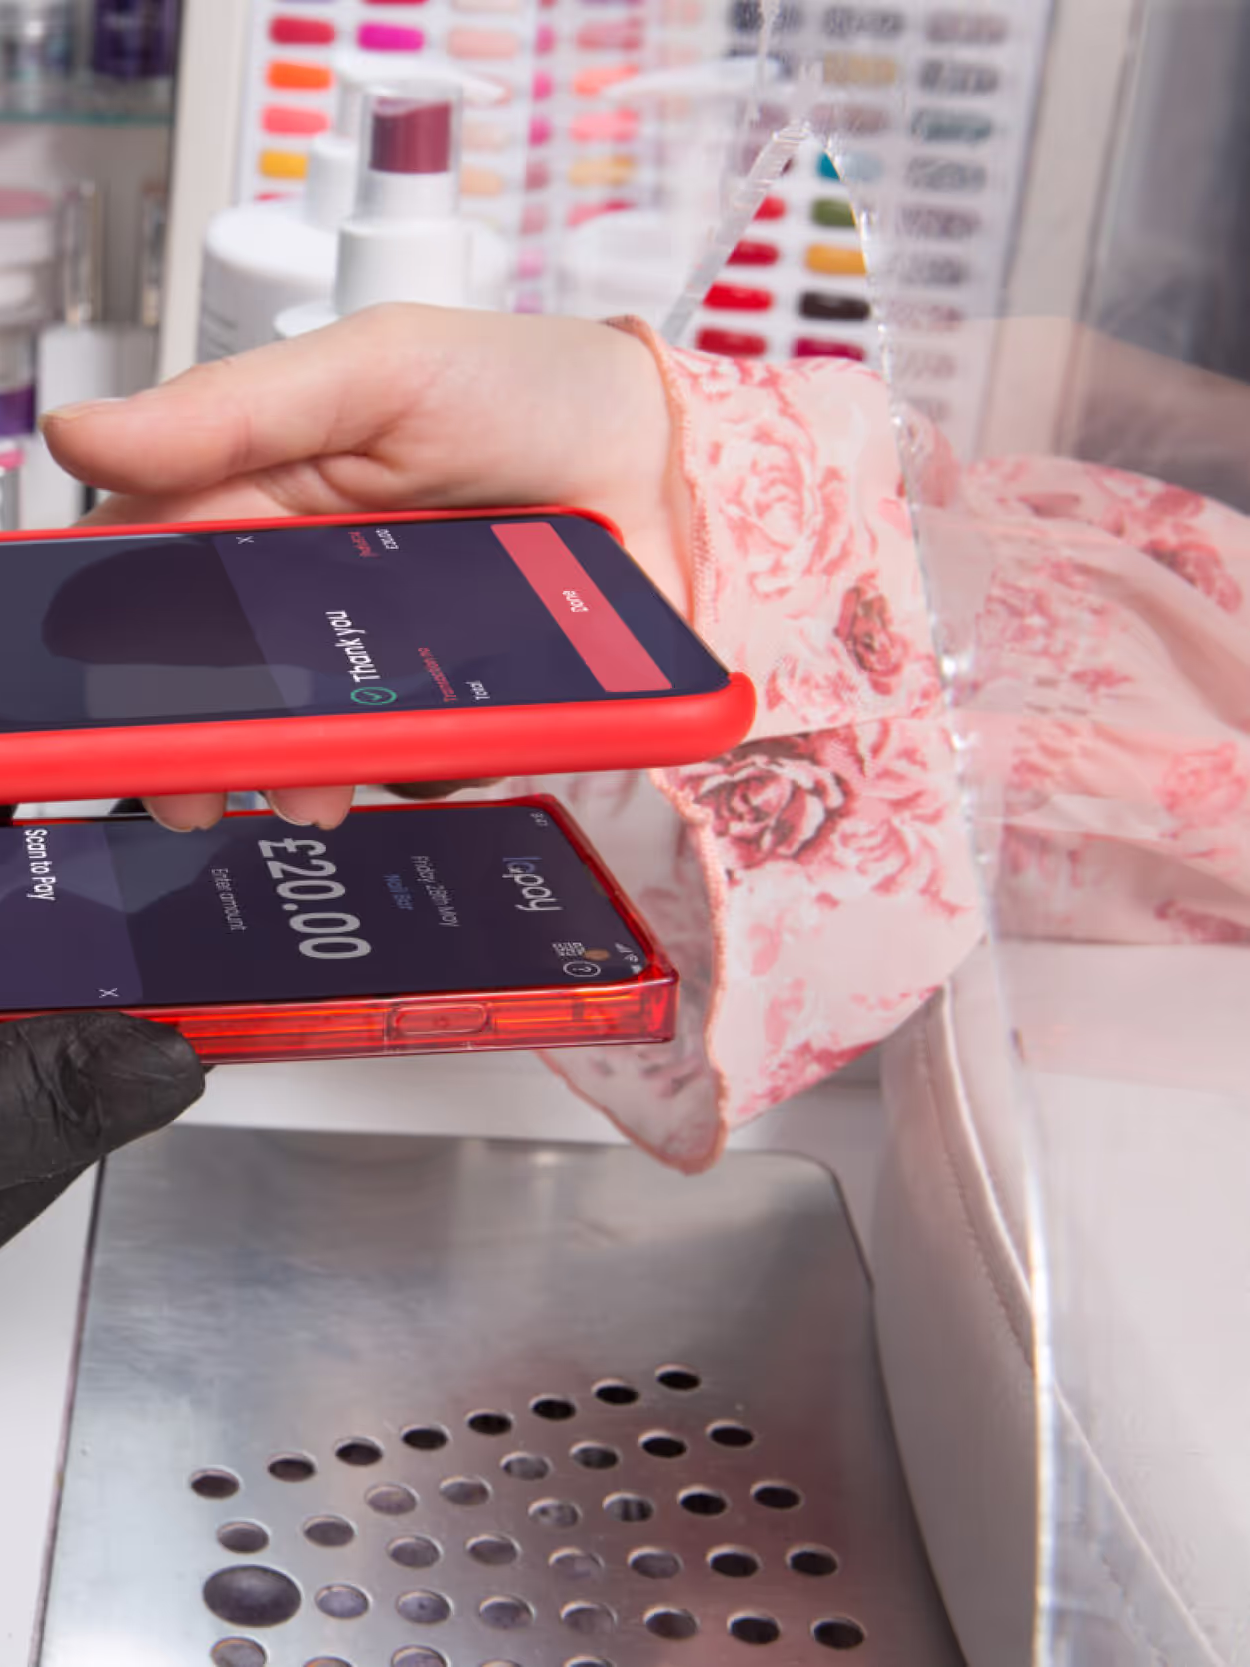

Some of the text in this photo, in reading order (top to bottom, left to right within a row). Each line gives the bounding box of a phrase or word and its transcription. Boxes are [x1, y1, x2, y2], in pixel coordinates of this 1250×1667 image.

[325, 610, 367, 637] you
[562, 590, 589, 613] Done
[335, 637, 381, 683] Thank
[465, 679, 491, 701] Total
[24, 828, 57, 901] Scan to Pay
[211, 868, 248, 932] Enter amount
[258, 837, 372, 960] £20.00
[383, 874, 414, 911] Nail Bar
[411, 855, 436, 883] Friday
[438, 906, 462, 927] May
